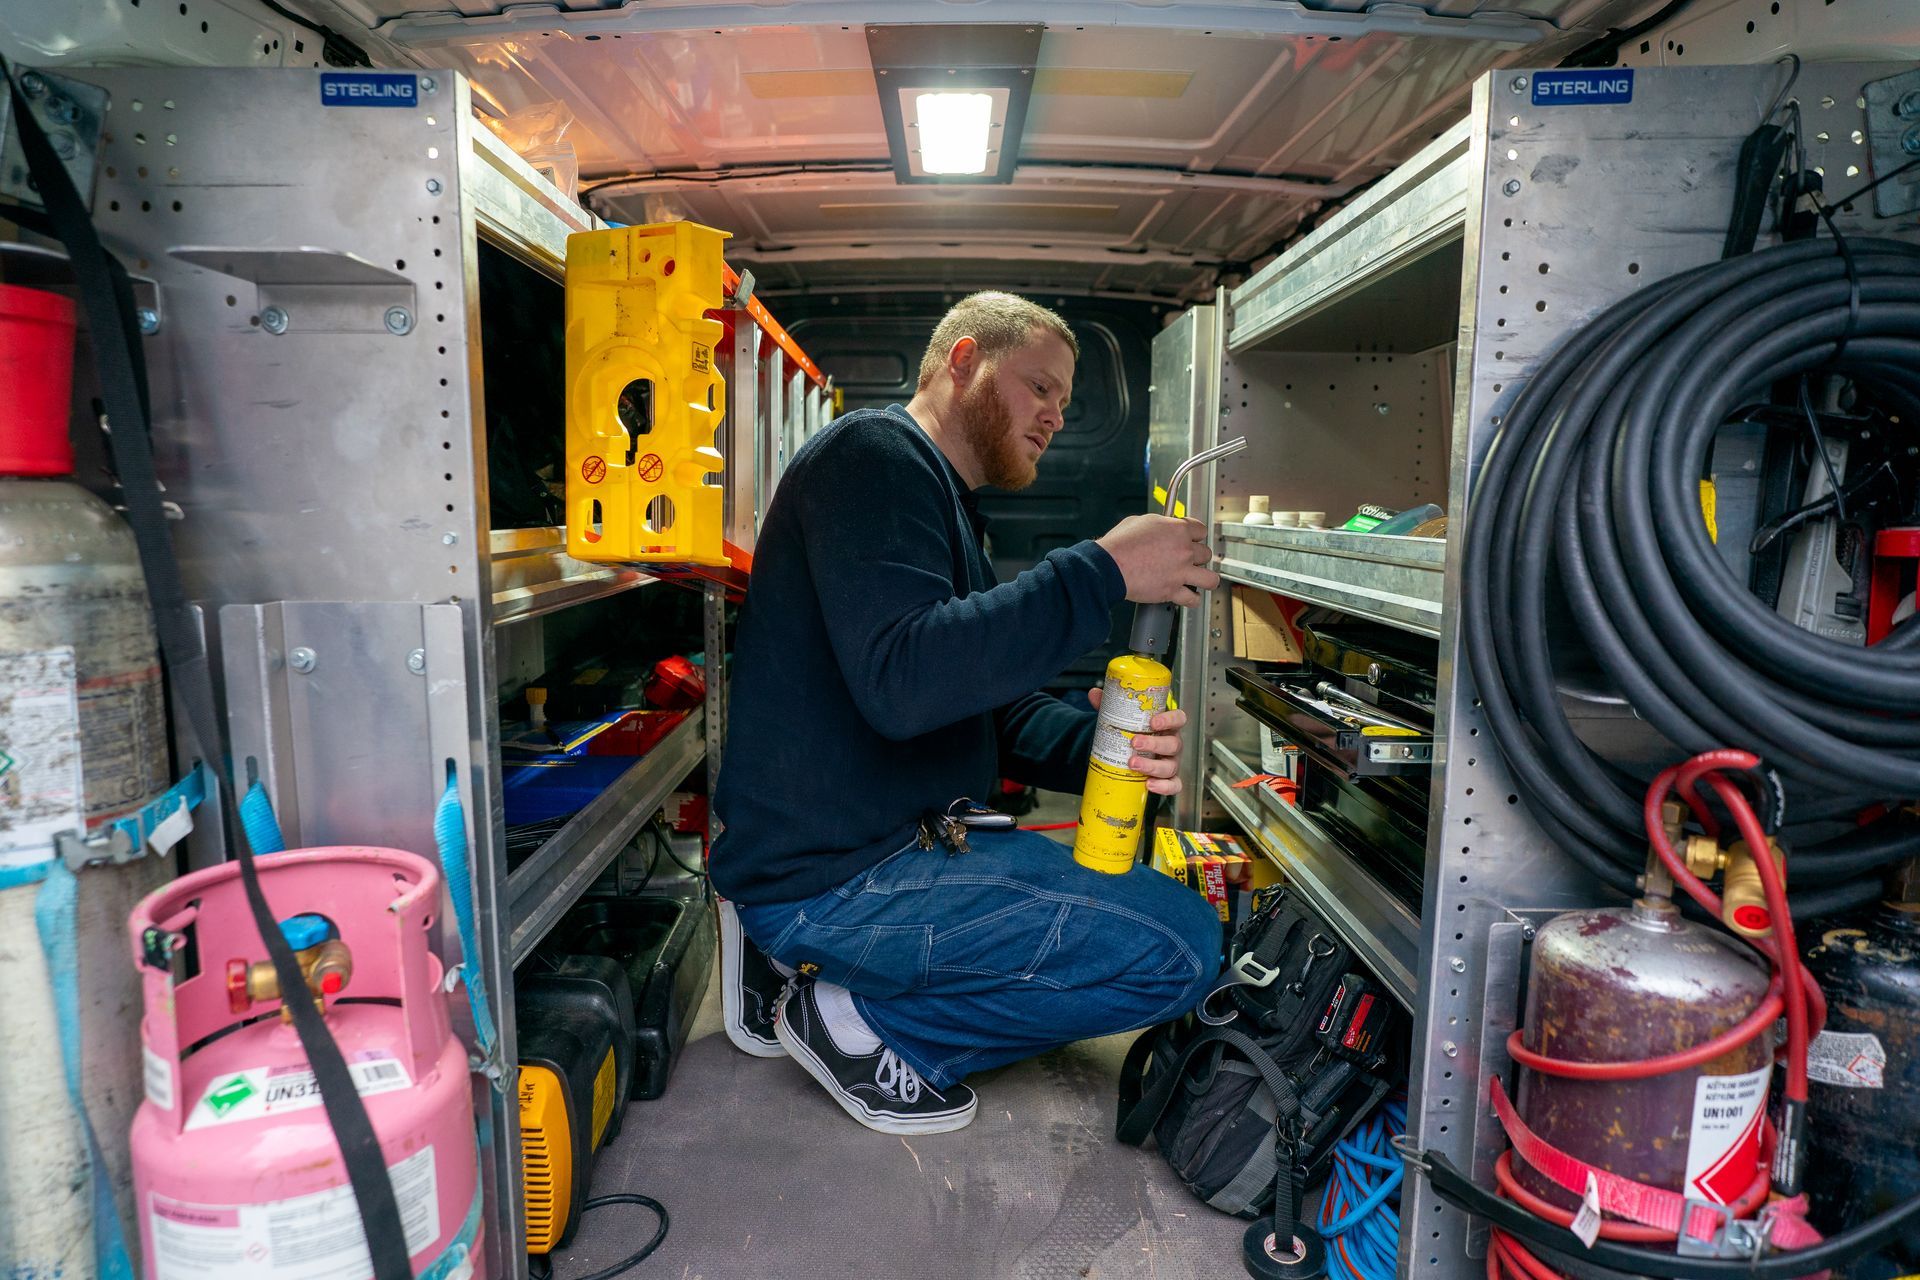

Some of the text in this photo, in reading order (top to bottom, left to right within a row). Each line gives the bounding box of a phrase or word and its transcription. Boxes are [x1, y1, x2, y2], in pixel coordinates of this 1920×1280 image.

[324, 82, 413, 97] STERLING
[1537, 80, 1629, 95] STERLING
[1205, 870, 1217, 896] FLAPS
[1212, 864, 1226, 900] TRUE TIE
[266, 1082, 321, 1102] UN31
[1703, 1106, 1744, 1118] UN1001
